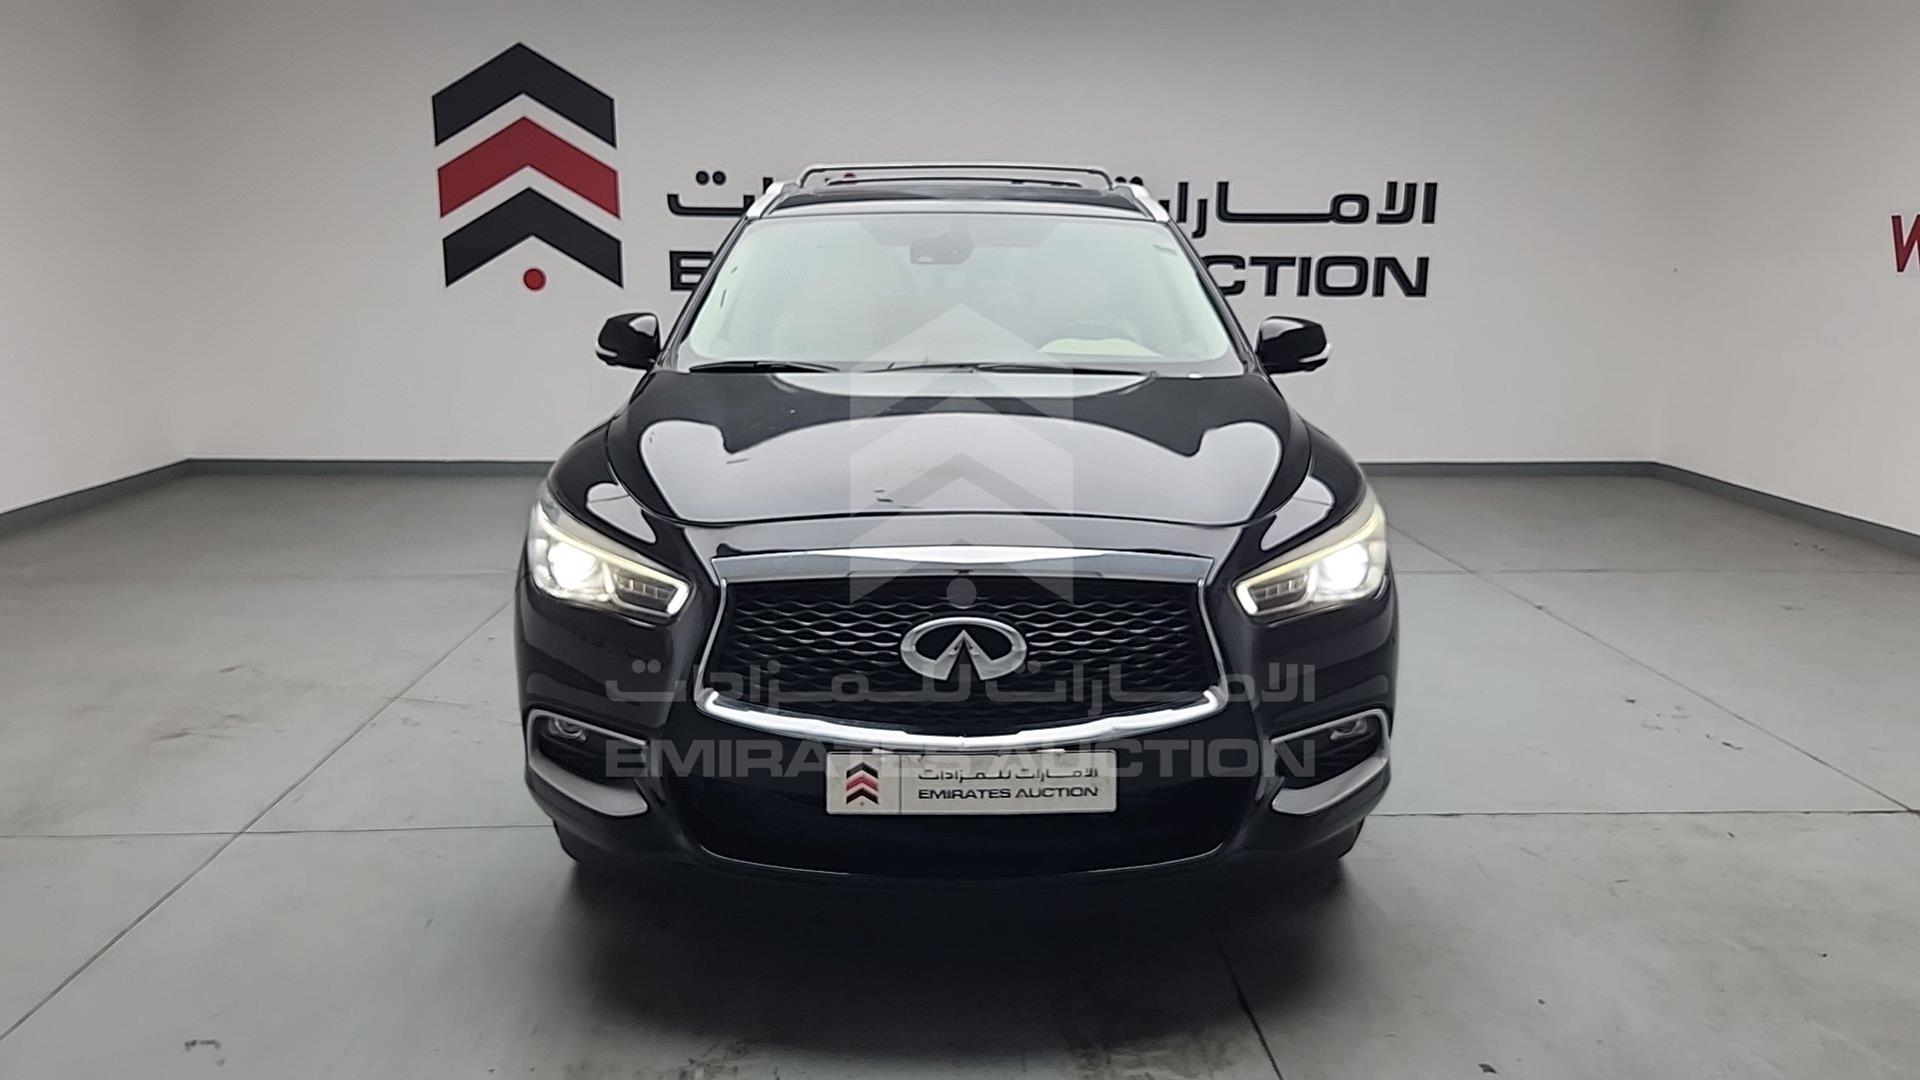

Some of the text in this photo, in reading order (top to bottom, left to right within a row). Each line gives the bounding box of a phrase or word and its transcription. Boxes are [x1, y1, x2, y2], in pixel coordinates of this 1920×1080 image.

[1115, 176, 1437, 239] الامارا
[1200, 255, 1429, 297] CTION
[918, 786, 1098, 800] EMIRATES AUCTION
